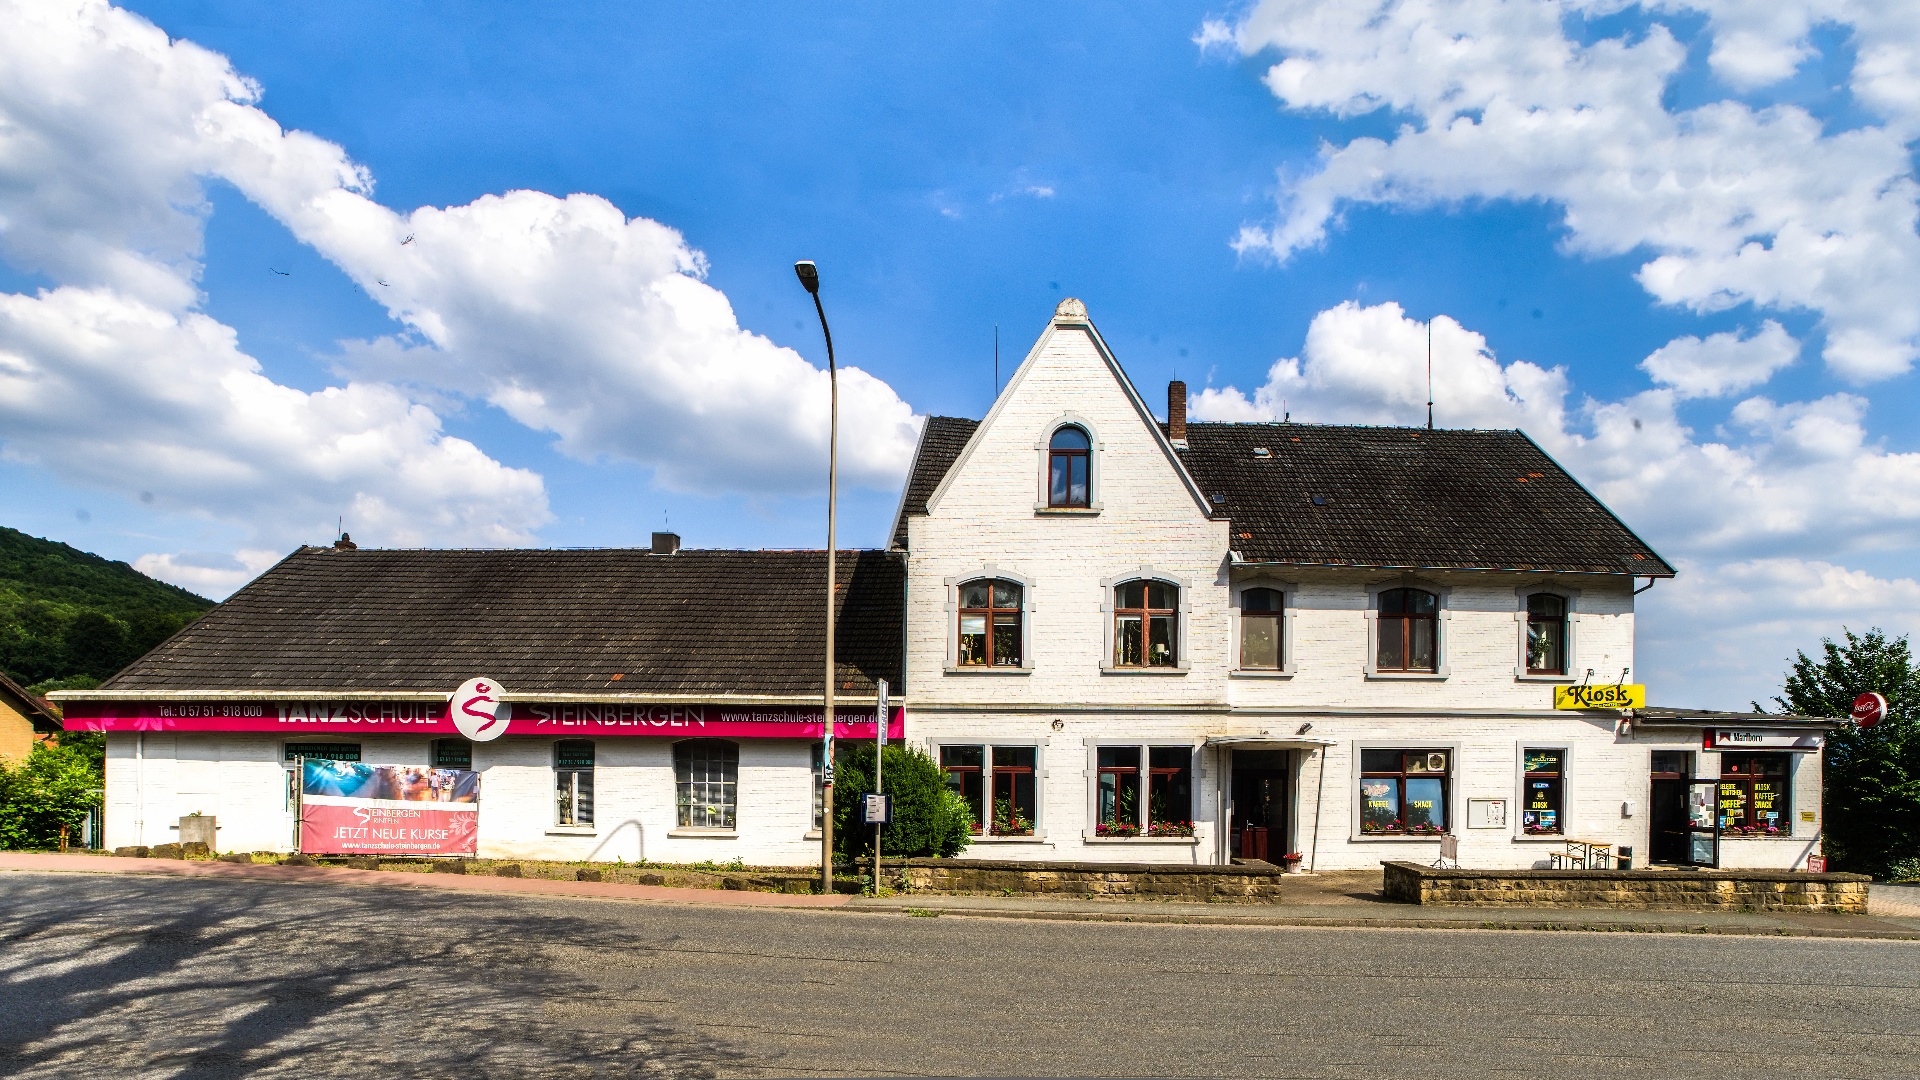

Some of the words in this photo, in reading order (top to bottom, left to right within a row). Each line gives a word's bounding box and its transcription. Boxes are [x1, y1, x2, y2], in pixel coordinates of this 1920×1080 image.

[1567, 684, 1633, 707] Kiosk
[159, 705, 177, 717] Tel.:
[180, 705, 186, 717] 0
[188, 705, 200, 717] 57
[203, 705, 215, 717] 51
[222, 705, 241, 717] 918
[243, 705, 262, 717] 000
[275, 701, 438, 723] TANZSCHULE
[529, 703, 705, 727] STEINBERGEN
[720, 711, 878, 725] www.tanzschule-steiergen.d
[1733, 732, 1763, 742] Marlboro
[1720, 800, 1741, 809] COFFEE
[1727, 817, 1735, 826] GO
[333, 827, 368, 838] JETZT
[372, 828, 406, 839] NEUE
[410, 829, 448, 840] KURSE
